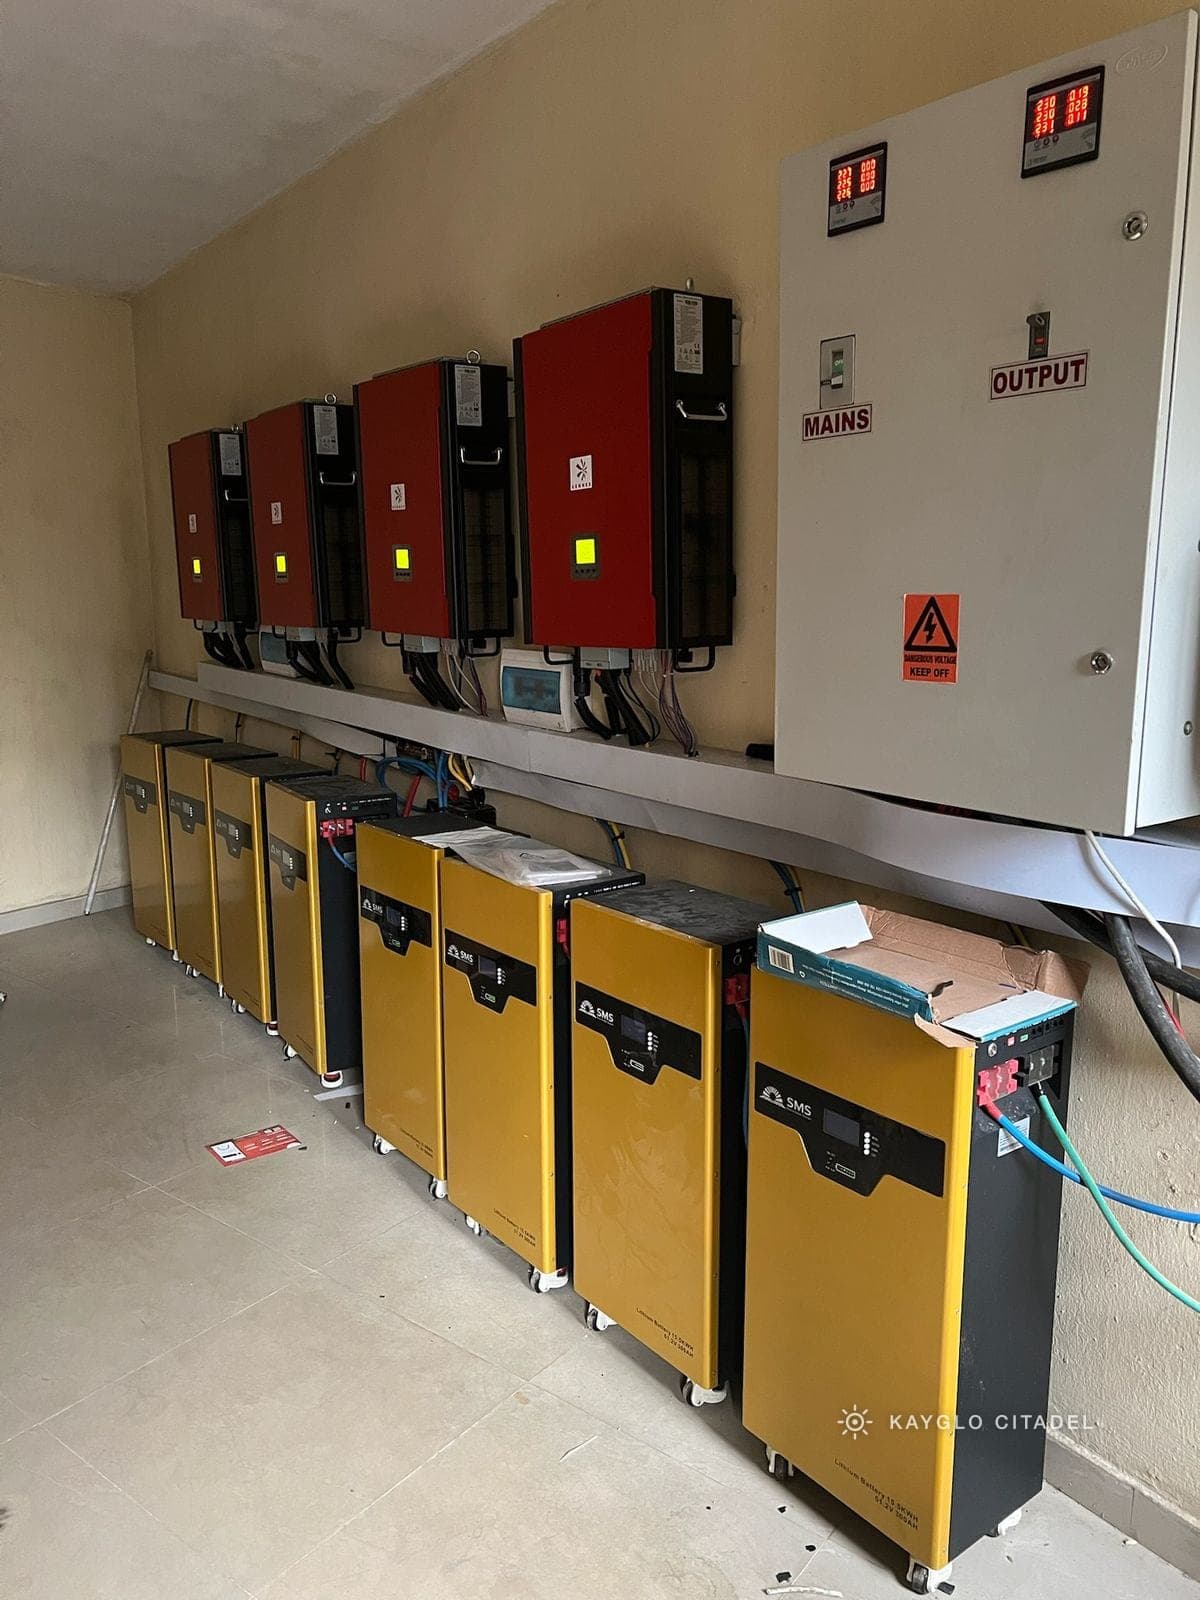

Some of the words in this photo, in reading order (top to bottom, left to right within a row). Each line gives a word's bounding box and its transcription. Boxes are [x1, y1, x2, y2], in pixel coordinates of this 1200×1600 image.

[1036, 95, 1056, 111] 230
[1035, 108, 1055, 123] 230
[993, 358, 1085, 394] OUTPUT
[805, 408, 869, 437] MAINS
[910, 666, 931, 677] KEEP
[934, 668, 950, 678] OFF
[460, 950, 474, 963] SMS
[596, 1007, 614, 1023] SMS
[786, 1096, 812, 1117] SMS
[860, 1477, 885, 1499] Battery
